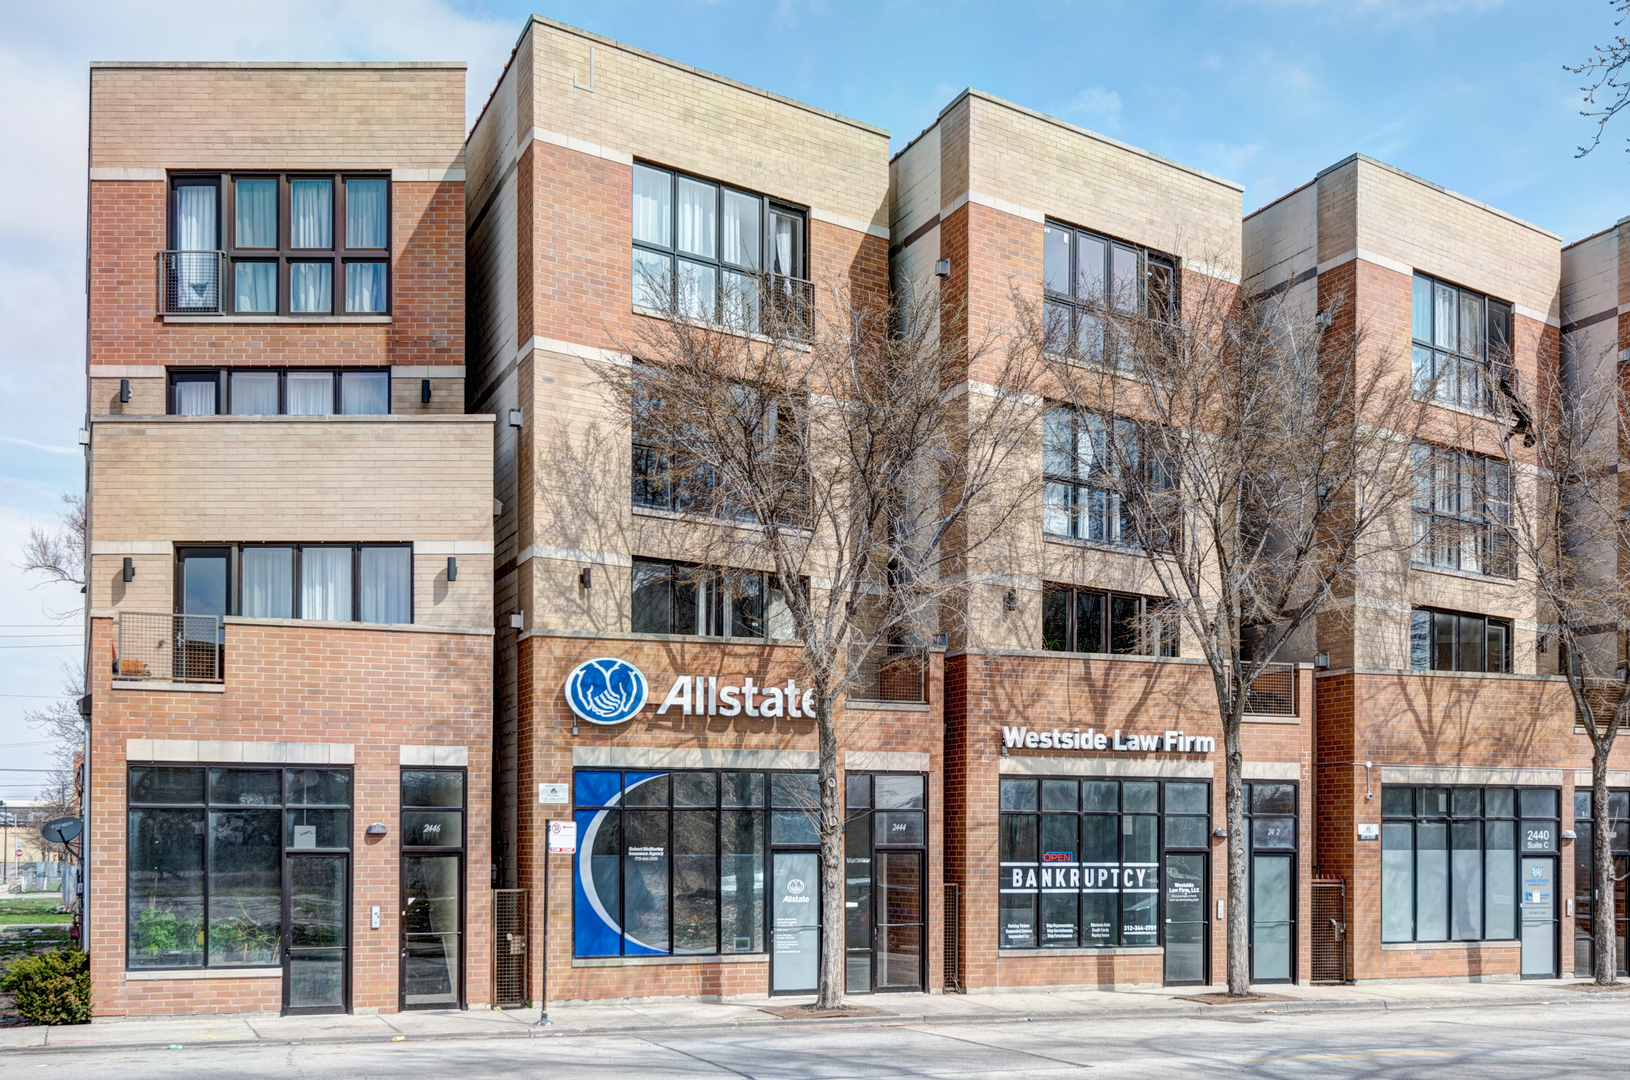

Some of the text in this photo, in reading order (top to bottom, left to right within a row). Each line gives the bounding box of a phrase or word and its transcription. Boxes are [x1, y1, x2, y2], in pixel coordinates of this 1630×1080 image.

[656, 675, 817, 718] Allstate
[1002, 726, 1215, 753] Westside Law Firm
[422, 823, 441, 833] 2446
[892, 823, 907, 831] 2444
[1527, 830, 1549, 840] 2440
[1527, 841, 1549, 849] Suite C
[1043, 853, 1071, 862] OPEN
[1012, 868, 1146, 887] BANKRUPTCY
[782, 895, 810, 903] Allstate
